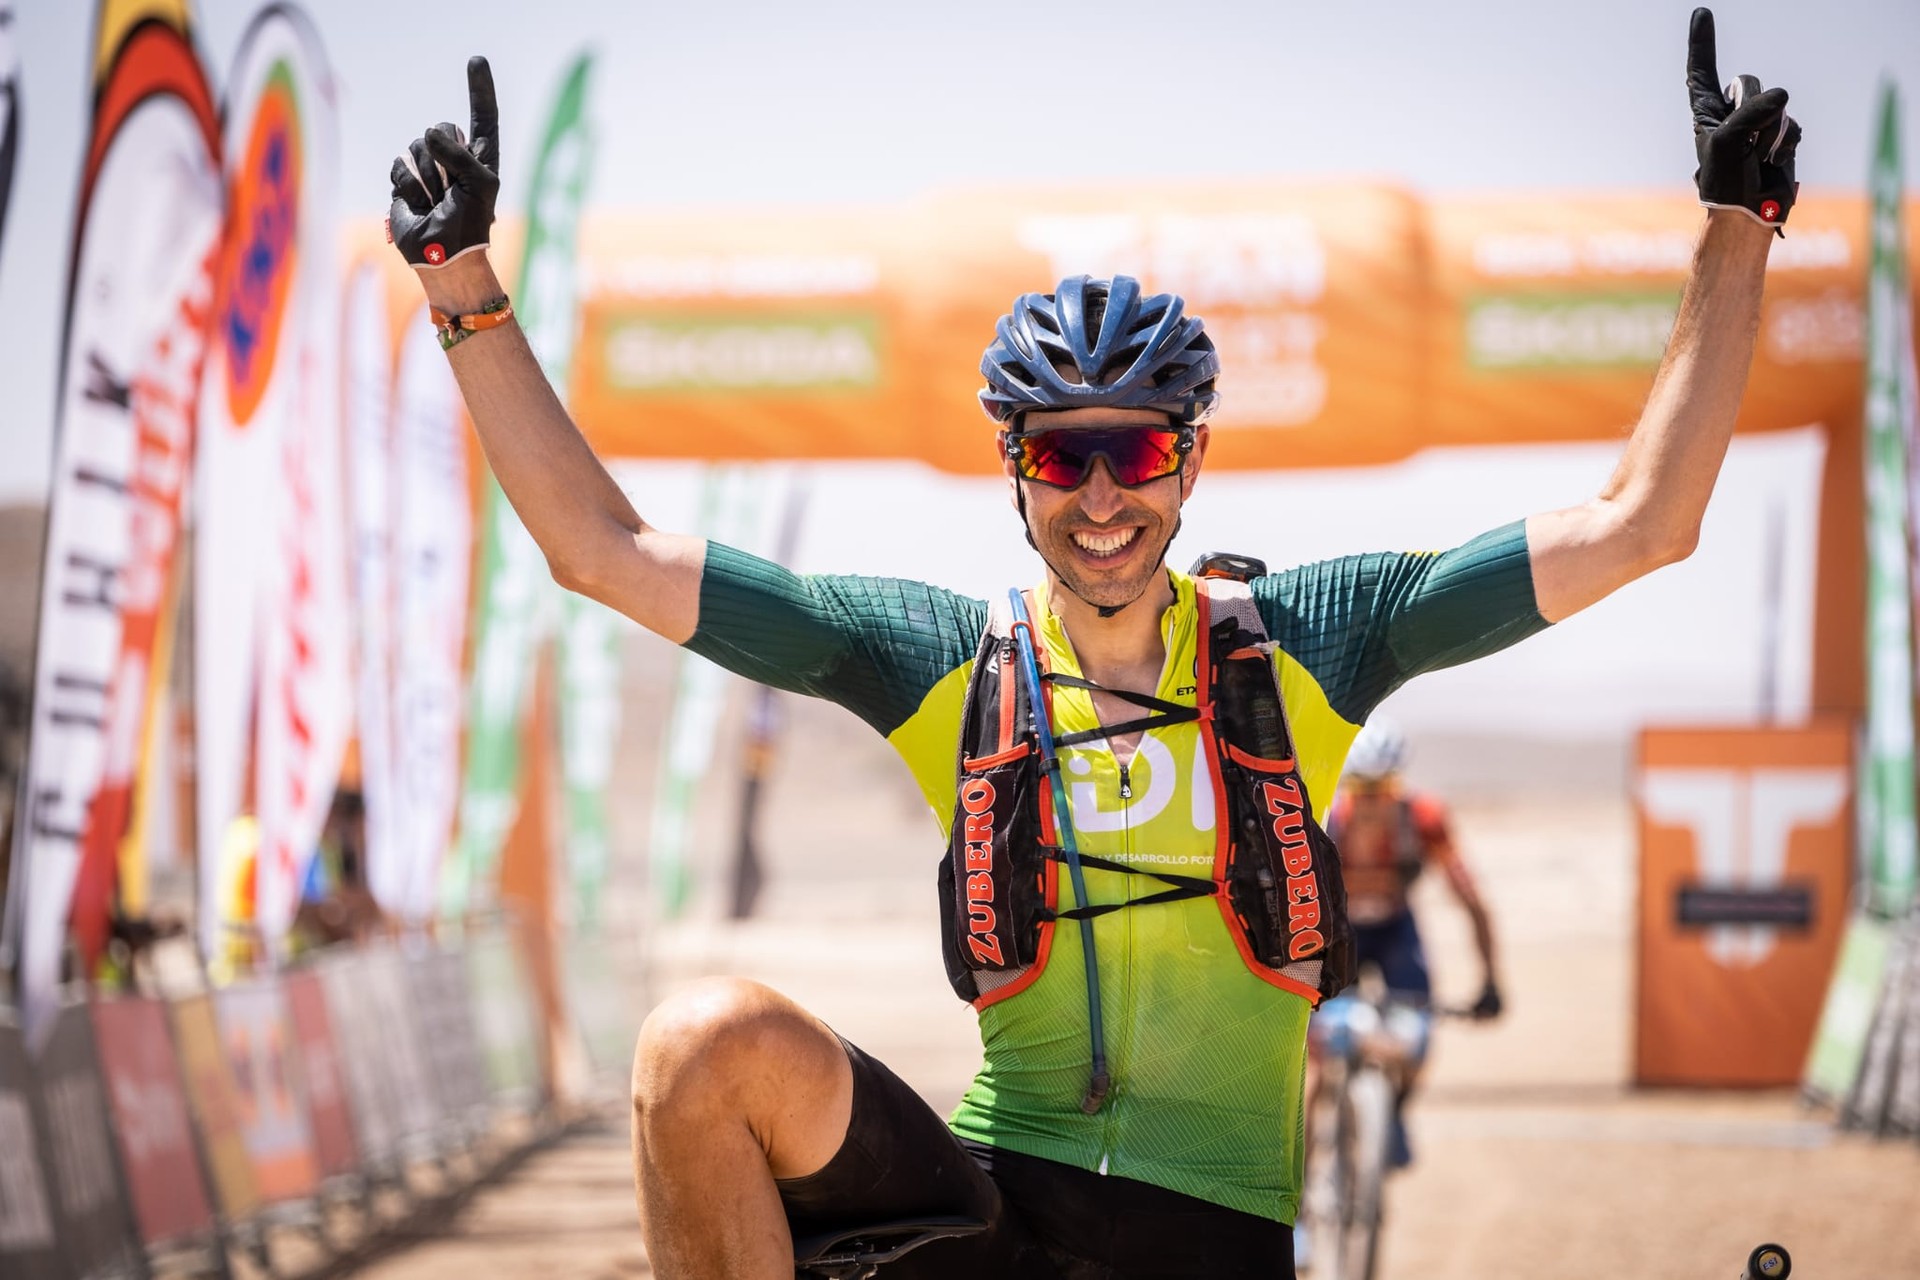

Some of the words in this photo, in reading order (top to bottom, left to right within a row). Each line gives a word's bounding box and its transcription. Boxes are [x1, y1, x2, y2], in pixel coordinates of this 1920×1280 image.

[961, 778, 1005, 966] ZUBERO
[1115, 853, 1188, 865] DESARROLLO
[1263, 777, 1325, 961] ZUBERO
